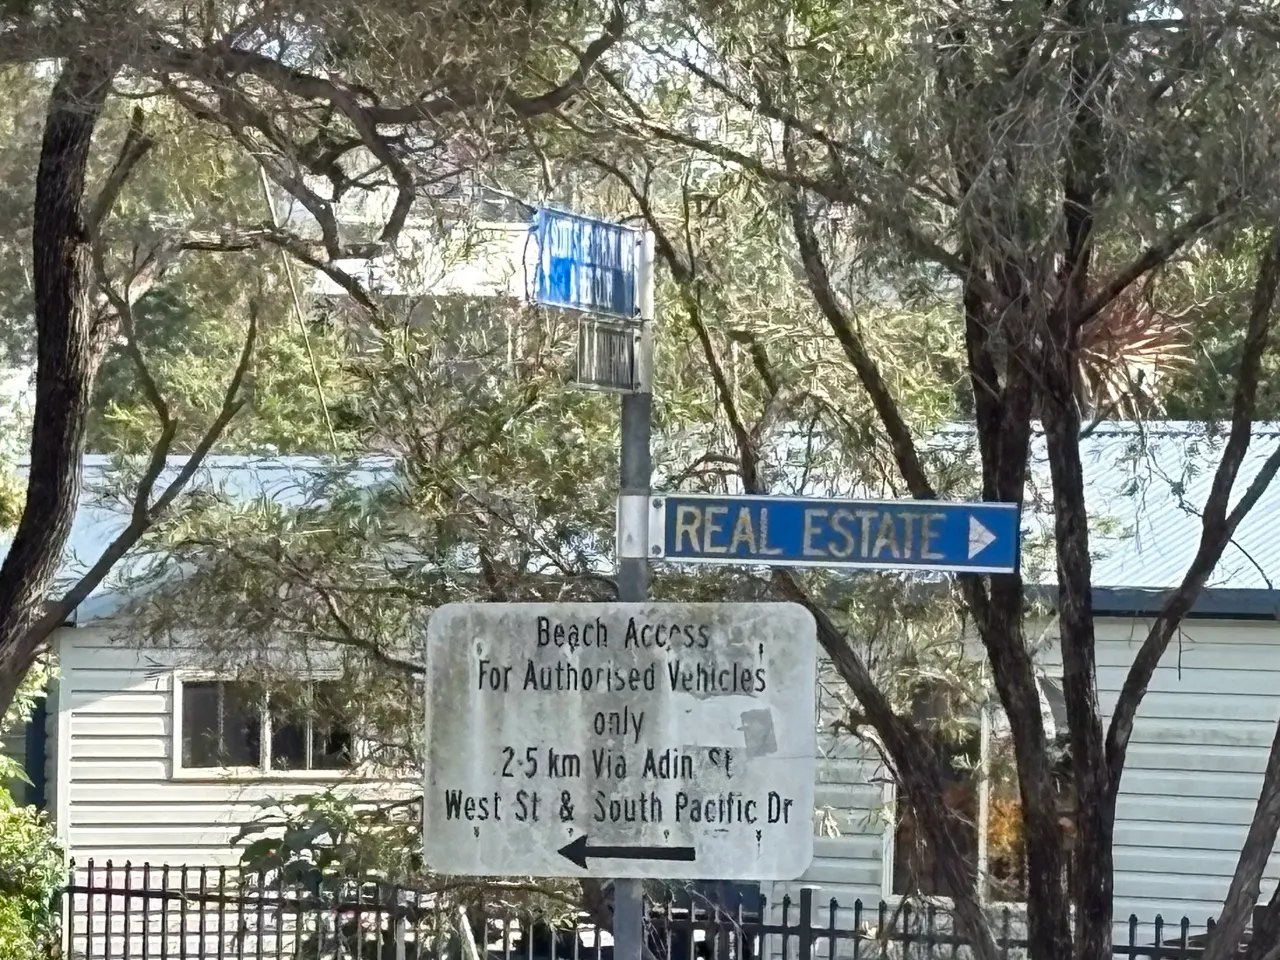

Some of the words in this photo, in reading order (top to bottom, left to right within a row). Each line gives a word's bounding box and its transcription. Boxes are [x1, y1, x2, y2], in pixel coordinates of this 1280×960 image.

[674, 505, 782, 555] REAL
[803, 508, 946, 560] ESTATE
[537, 616, 608, 650] Beach
[625, 617, 710, 650] Access
[478, 659, 513, 691] For
[523, 660, 656, 692] Authorised
[667, 662, 767, 693] Vehicles
[593, 706, 645, 744] only
[548, 747, 580, 779] km
[592, 748, 626, 779] Via
[642, 748, 694, 779] Adin
[445, 789, 502, 821] West
[515, 790, 541, 822] St
[558, 792, 574, 821] &
[593, 792, 663, 823] South
[674, 792, 758, 824] Pacific
[767, 791, 794, 824] Dr
